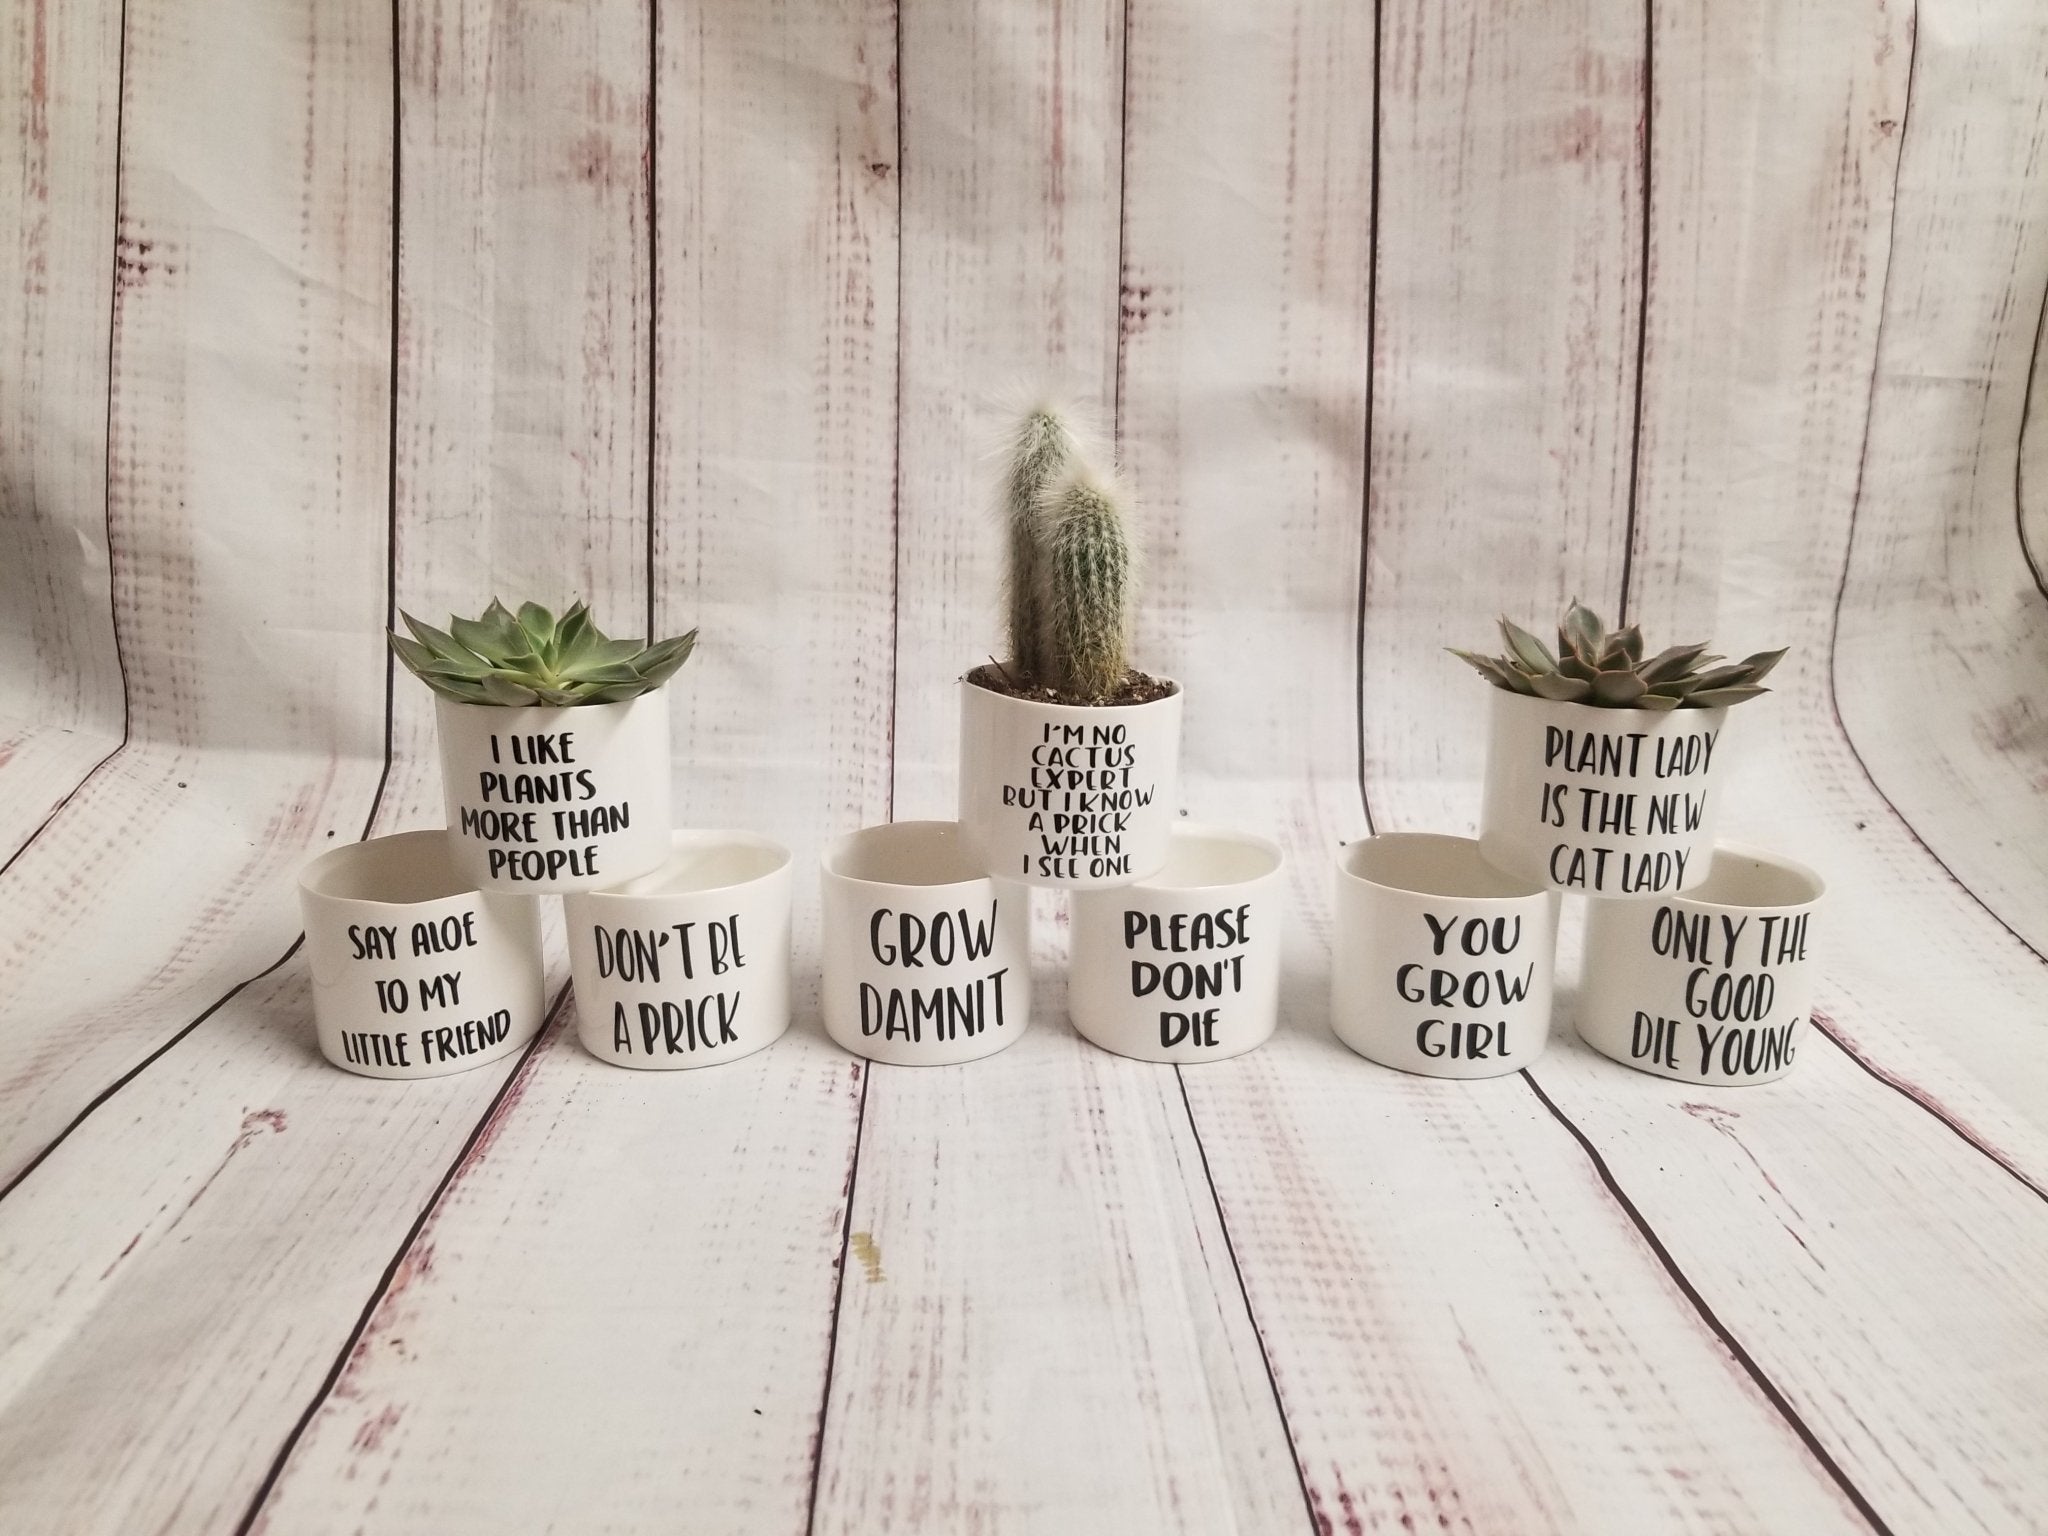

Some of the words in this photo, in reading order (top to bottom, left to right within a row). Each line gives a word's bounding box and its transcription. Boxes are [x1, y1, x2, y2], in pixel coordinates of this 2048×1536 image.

[490, 734, 501, 765] I
[511, 732, 576, 765] LIKE
[1031, 744, 1136, 769] CACTUS
[1043, 722, 1084, 746] I'M
[1092, 724, 1127, 746] NO
[1544, 725, 1649, 778] PLANT
[1655, 728, 1720, 779] LADY
[479, 769, 597, 805] PLANTS
[1002, 784, 1053, 811] BUT
[1064, 791, 1071, 813] I
[1079, 783, 1155, 813] KNOW
[1030, 766, 1134, 791] EXPERT
[460, 805, 538, 844] MORE
[551, 801, 630, 841] THAN
[1028, 811, 1044, 833] A
[1053, 811, 1133, 835] PRICK
[1540, 782, 1569, 829] IS
[1578, 787, 1638, 836] THE
[1646, 788, 1707, 836] NEW
[487, 845, 600, 881] PEOPLE
[1023, 854, 1030, 875] I
[1037, 855, 1080, 879] SEE
[1089, 855, 1133, 878] ONE
[1040, 834, 1121, 856] WHEN
[1549, 843, 1614, 891] CAT
[1621, 846, 1691, 894] LADY
[347, 924, 398, 961] SAY
[411, 911, 478, 958] ALOE
[594, 921, 697, 984] DON'T
[708, 913, 747, 977] BE
[870, 897, 999, 968] GROW
[1123, 903, 1252, 953] PLEASE
[1422, 912, 1522, 957] YOU
[1651, 905, 1749, 967] ONLY
[1757, 911, 1812, 968] THE
[374, 978, 409, 1014] TO
[418, 970, 462, 1012] MY
[1131, 953, 1246, 1001] DON'T
[1395, 961, 1535, 1009] GROW
[1685, 967, 1776, 1023] GOOD
[613, 1000, 633, 1055] A
[637, 990, 741, 1056] PRICK
[859, 967, 1010, 1043] DAMNIT
[1160, 1007, 1221, 1049] DIE
[341, 1029, 411, 1067] LITTLE
[421, 1008, 512, 1065] FRIEND
[1415, 1018, 1512, 1061] GIRL
[1630, 1010, 1681, 1071] DIE
[1695, 1016, 1800, 1077] YOUNG
